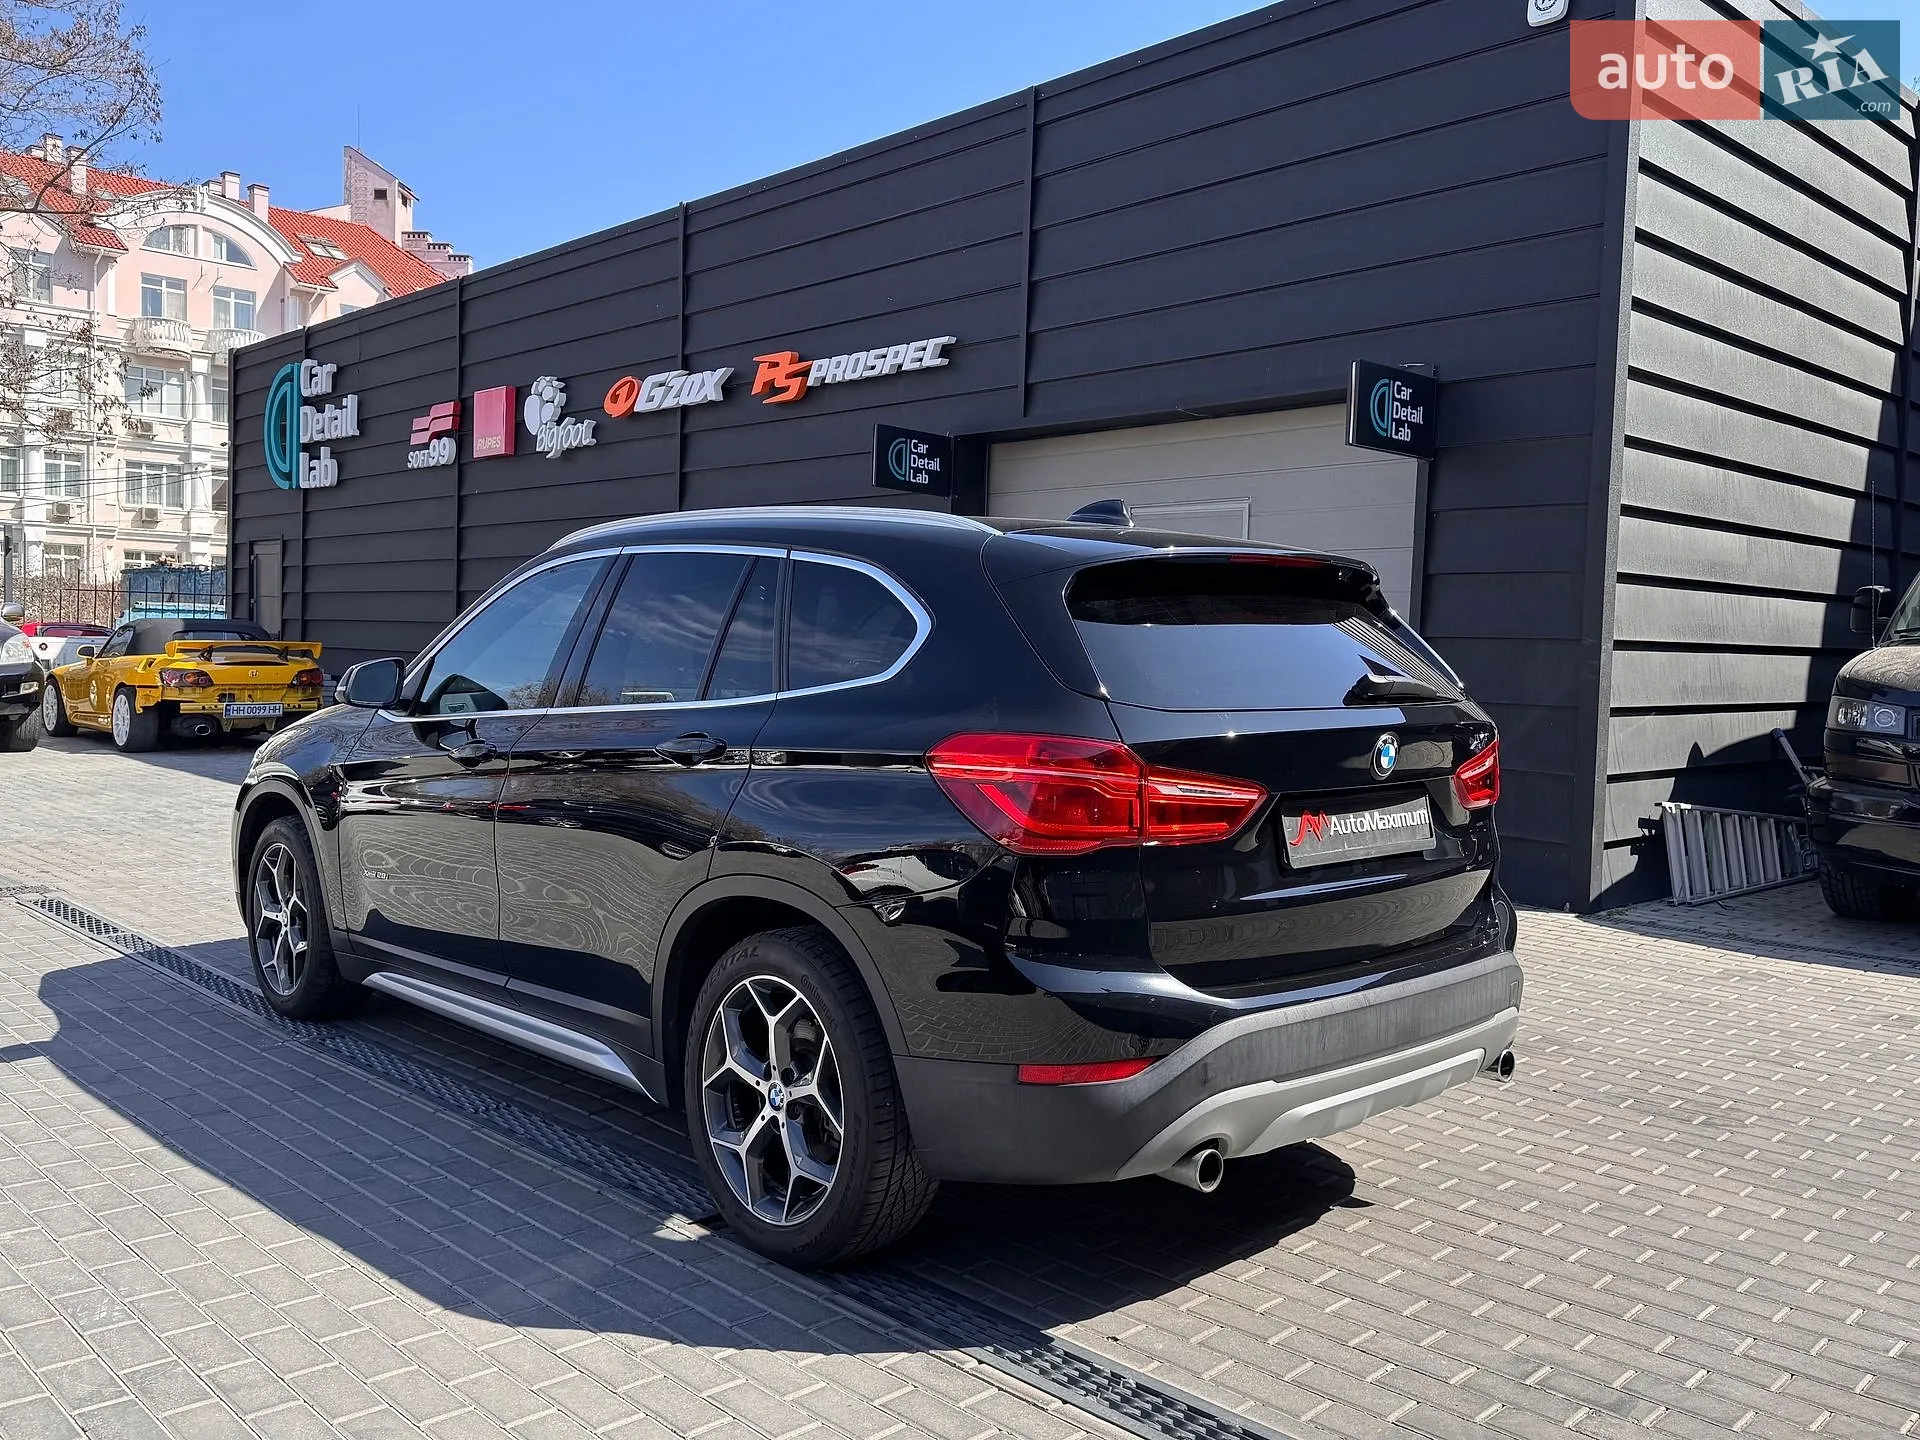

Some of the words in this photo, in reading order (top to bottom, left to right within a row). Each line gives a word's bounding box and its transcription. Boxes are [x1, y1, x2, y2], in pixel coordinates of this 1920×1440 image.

[807, 335, 957, 387] PROSPEC
[300, 358, 337, 397] Car
[1394, 381, 1412, 400] Car
[300, 394, 360, 444] Detail
[1392, 401, 1423, 425] Detail
[1391, 421, 1411, 442] Lab
[407, 436, 457, 469] SOFT99
[476, 435, 502, 451] RUPES
[910, 439, 929, 454] Car
[299, 446, 338, 489] Lab
[910, 454, 941, 472] Detail
[910, 469, 929, 484] Lab
[231, 705, 245, 715] HH
[246, 705, 267, 715] 0099
[268, 705, 281, 714] HH
[1330, 808, 1430, 836] AutoMaximum
